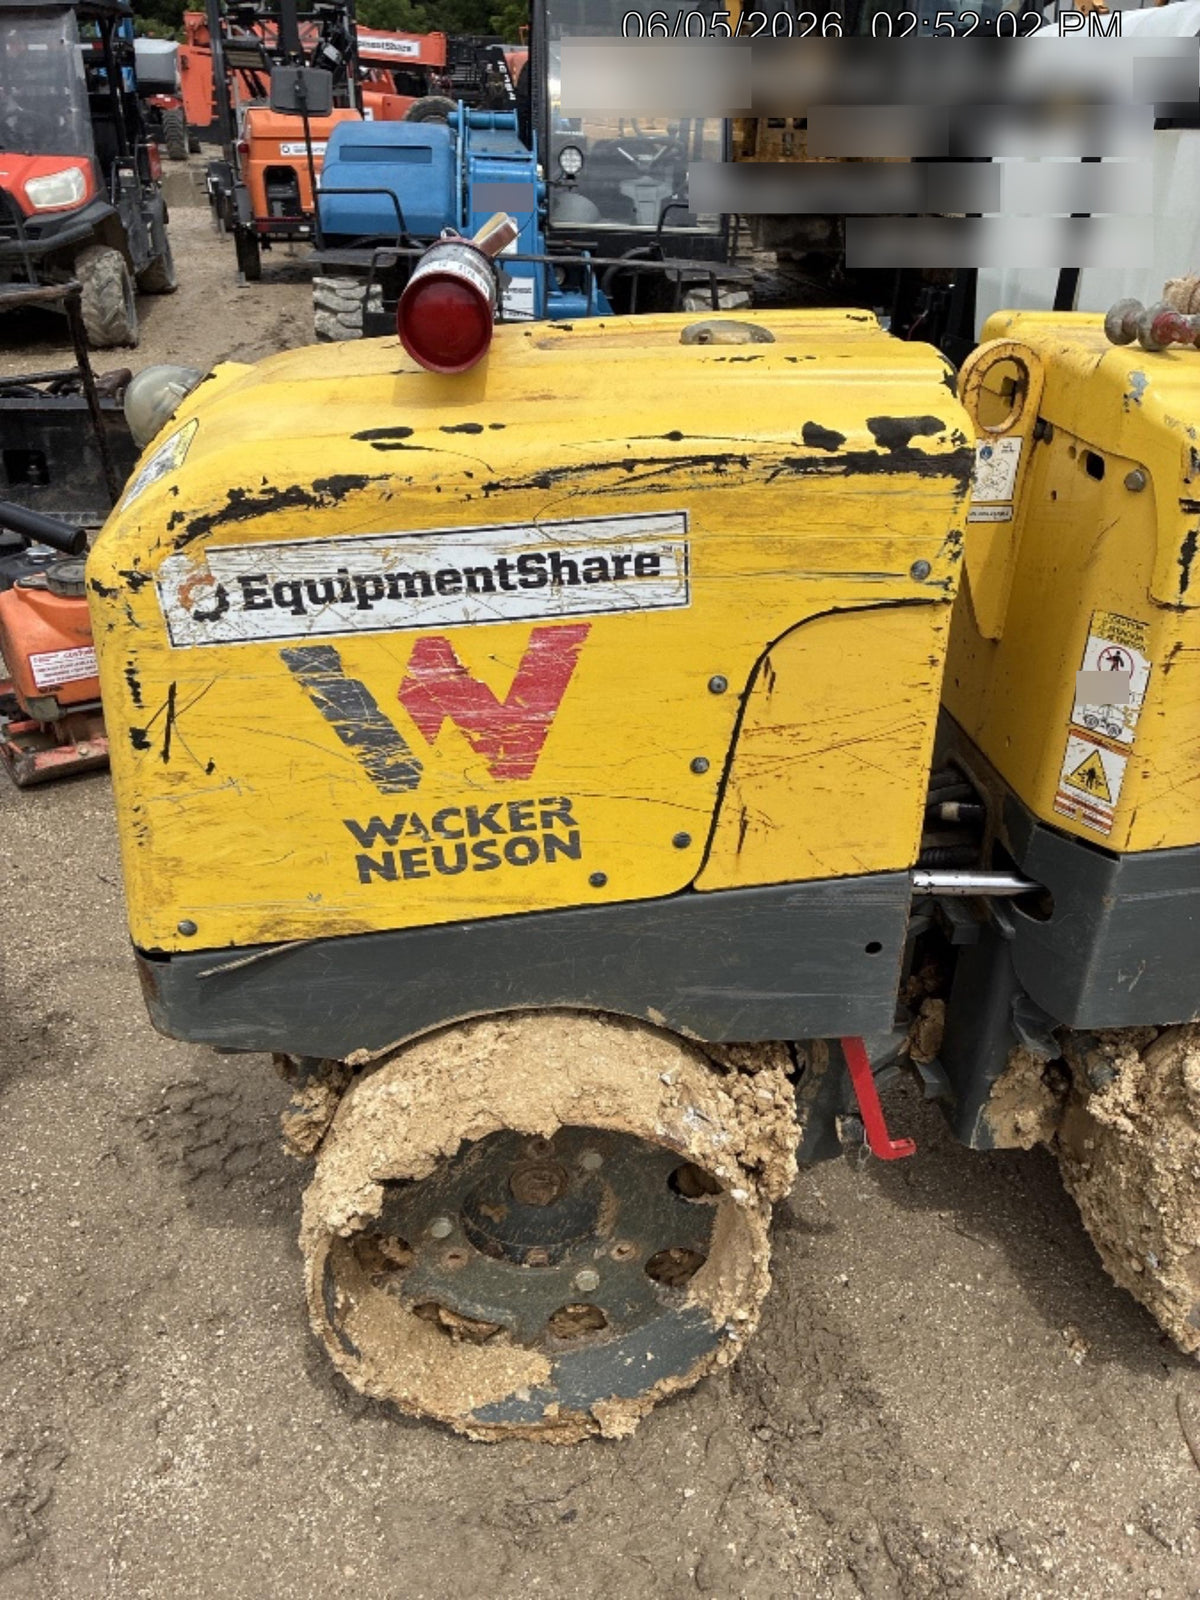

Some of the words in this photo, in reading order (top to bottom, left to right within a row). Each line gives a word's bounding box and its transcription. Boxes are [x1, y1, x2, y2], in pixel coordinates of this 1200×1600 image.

[236, 550, 661, 616] EquipmentShare
[342, 796, 579, 849] WACKER
[355, 829, 582, 884] NEUSON
